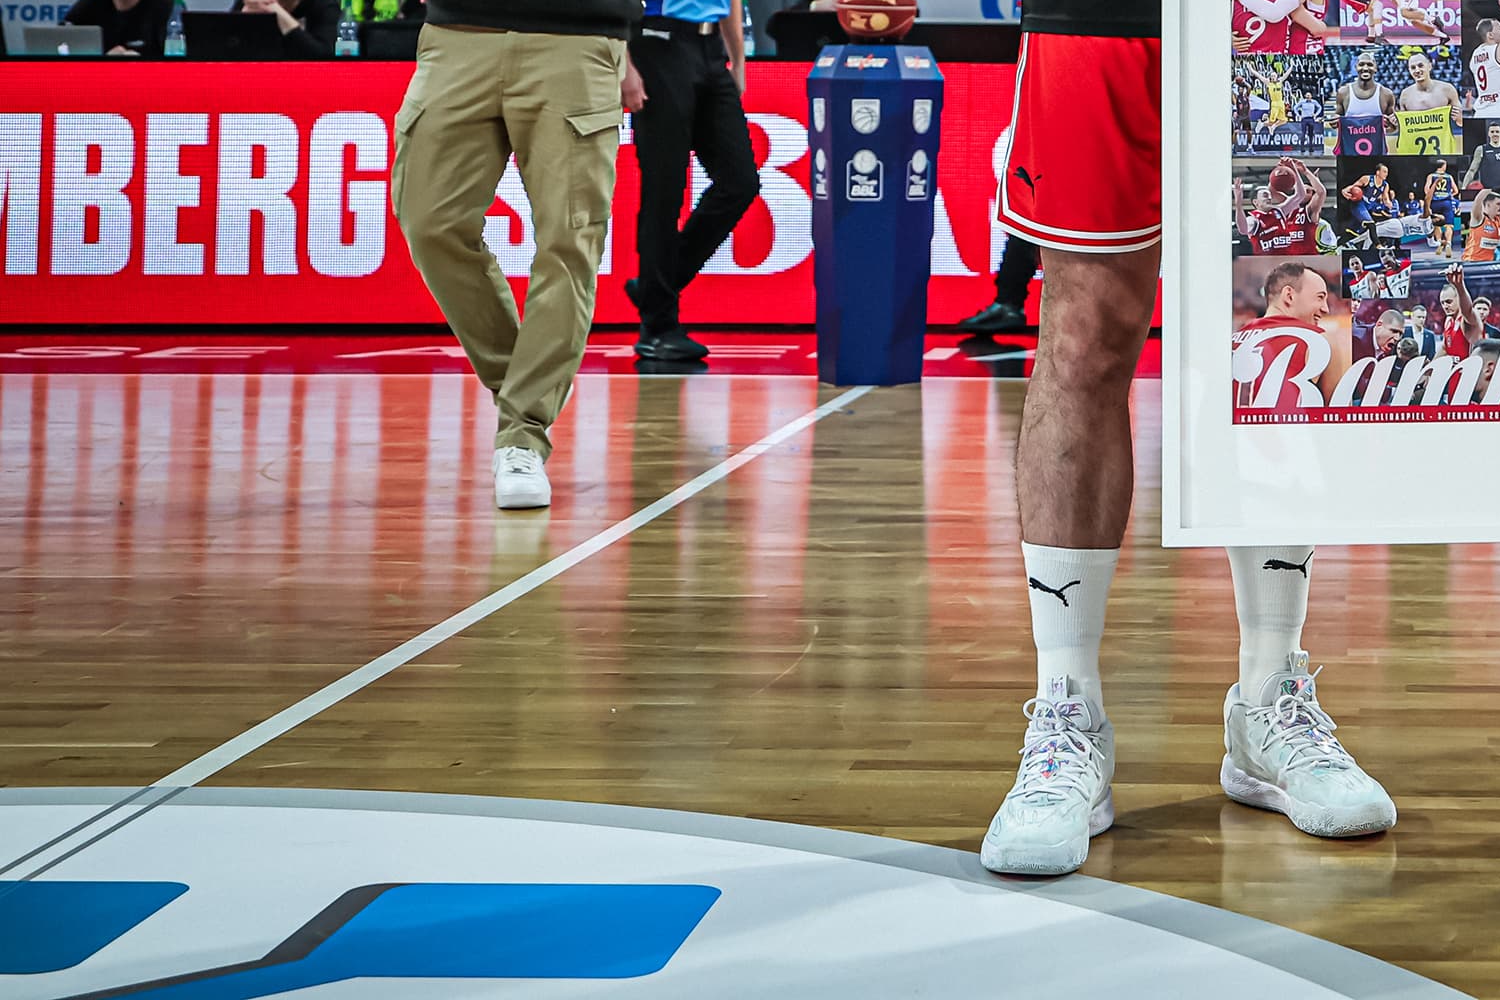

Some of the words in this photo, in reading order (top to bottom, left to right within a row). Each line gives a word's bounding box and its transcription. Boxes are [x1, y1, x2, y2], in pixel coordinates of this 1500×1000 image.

[1245, 16, 1266, 43] 9
[1477, 65, 1487, 91] 9
[1404, 114, 1444, 127] PAULDING
[1347, 124, 1376, 135] Tadda
[1414, 135, 1441, 155] 23
[1295, 213, 1305, 225] 20
[1259, 234, 1292, 251] brose
[1398, 285, 1407, 296] 17
[1240, 414, 1279, 423] KARSTEN
[1282, 413, 1309, 423] TADDA
[1346, 412, 1425, 422] BUNDESLIGASPIEL
